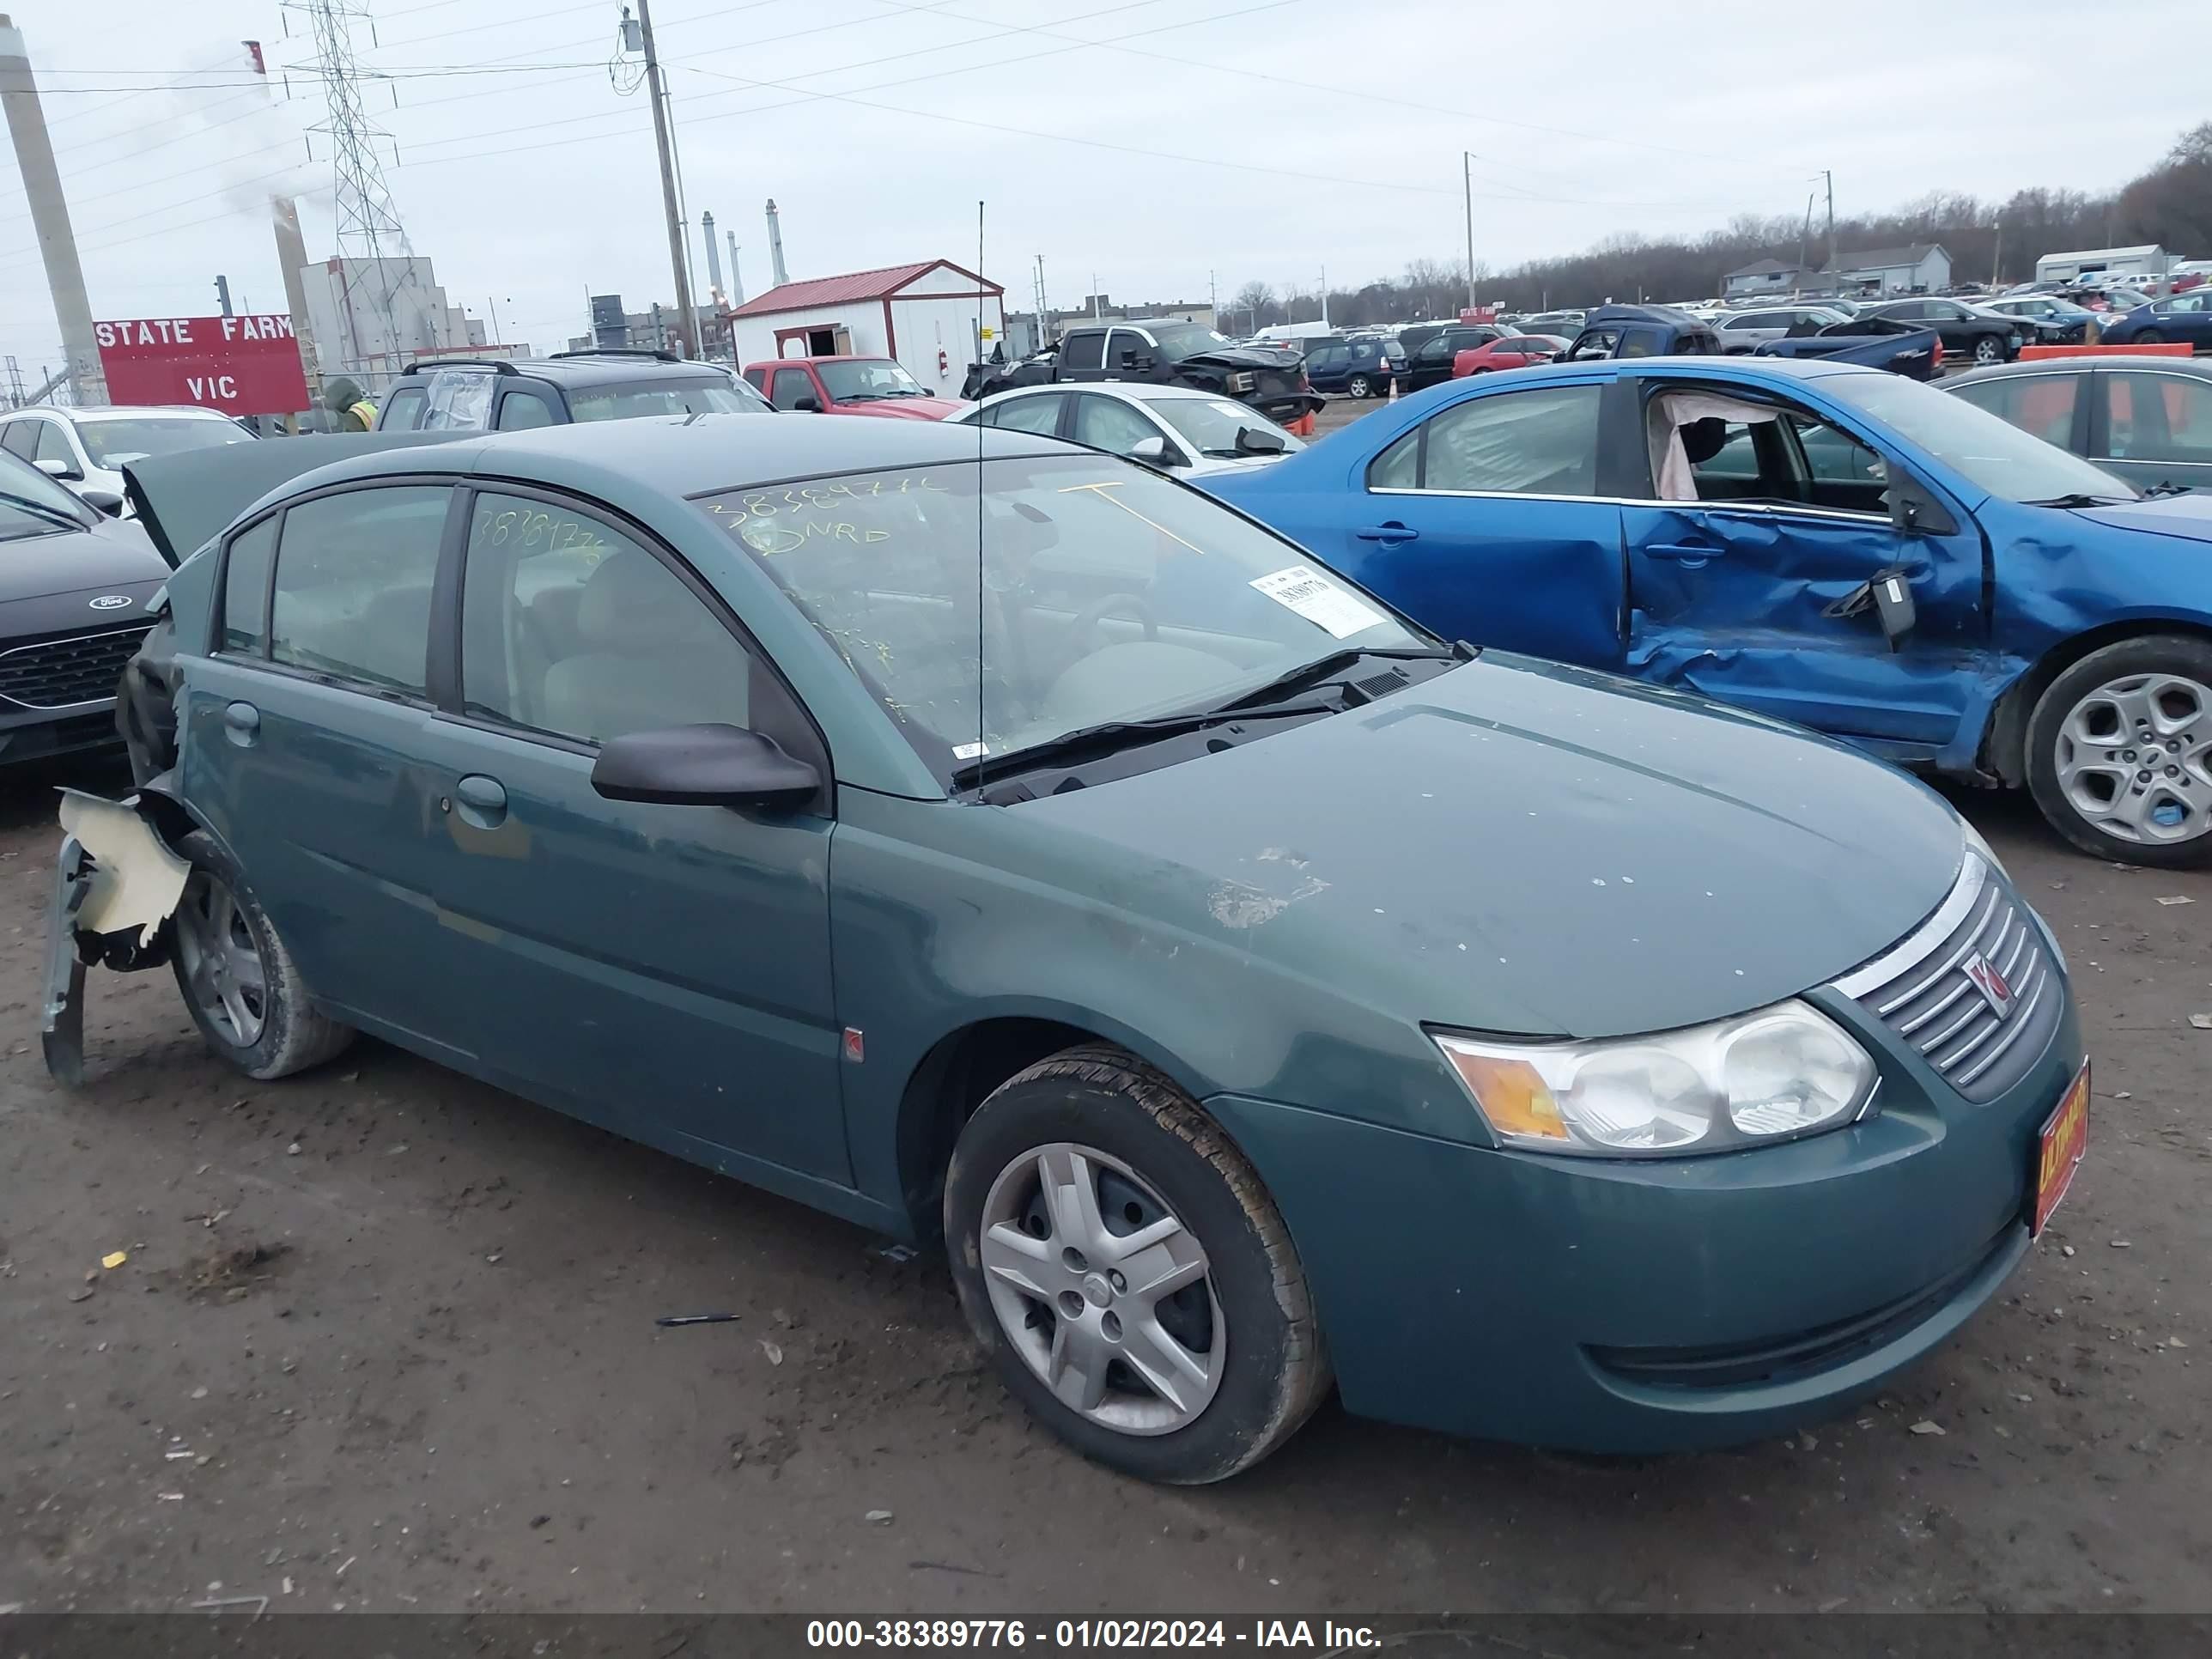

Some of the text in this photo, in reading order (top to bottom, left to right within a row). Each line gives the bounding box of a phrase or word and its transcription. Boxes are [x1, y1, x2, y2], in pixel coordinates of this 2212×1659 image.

[95, 315, 295, 348] STATE FARM
[186, 376, 237, 400] VIC
[1276, 580, 1330, 603] 38389776
